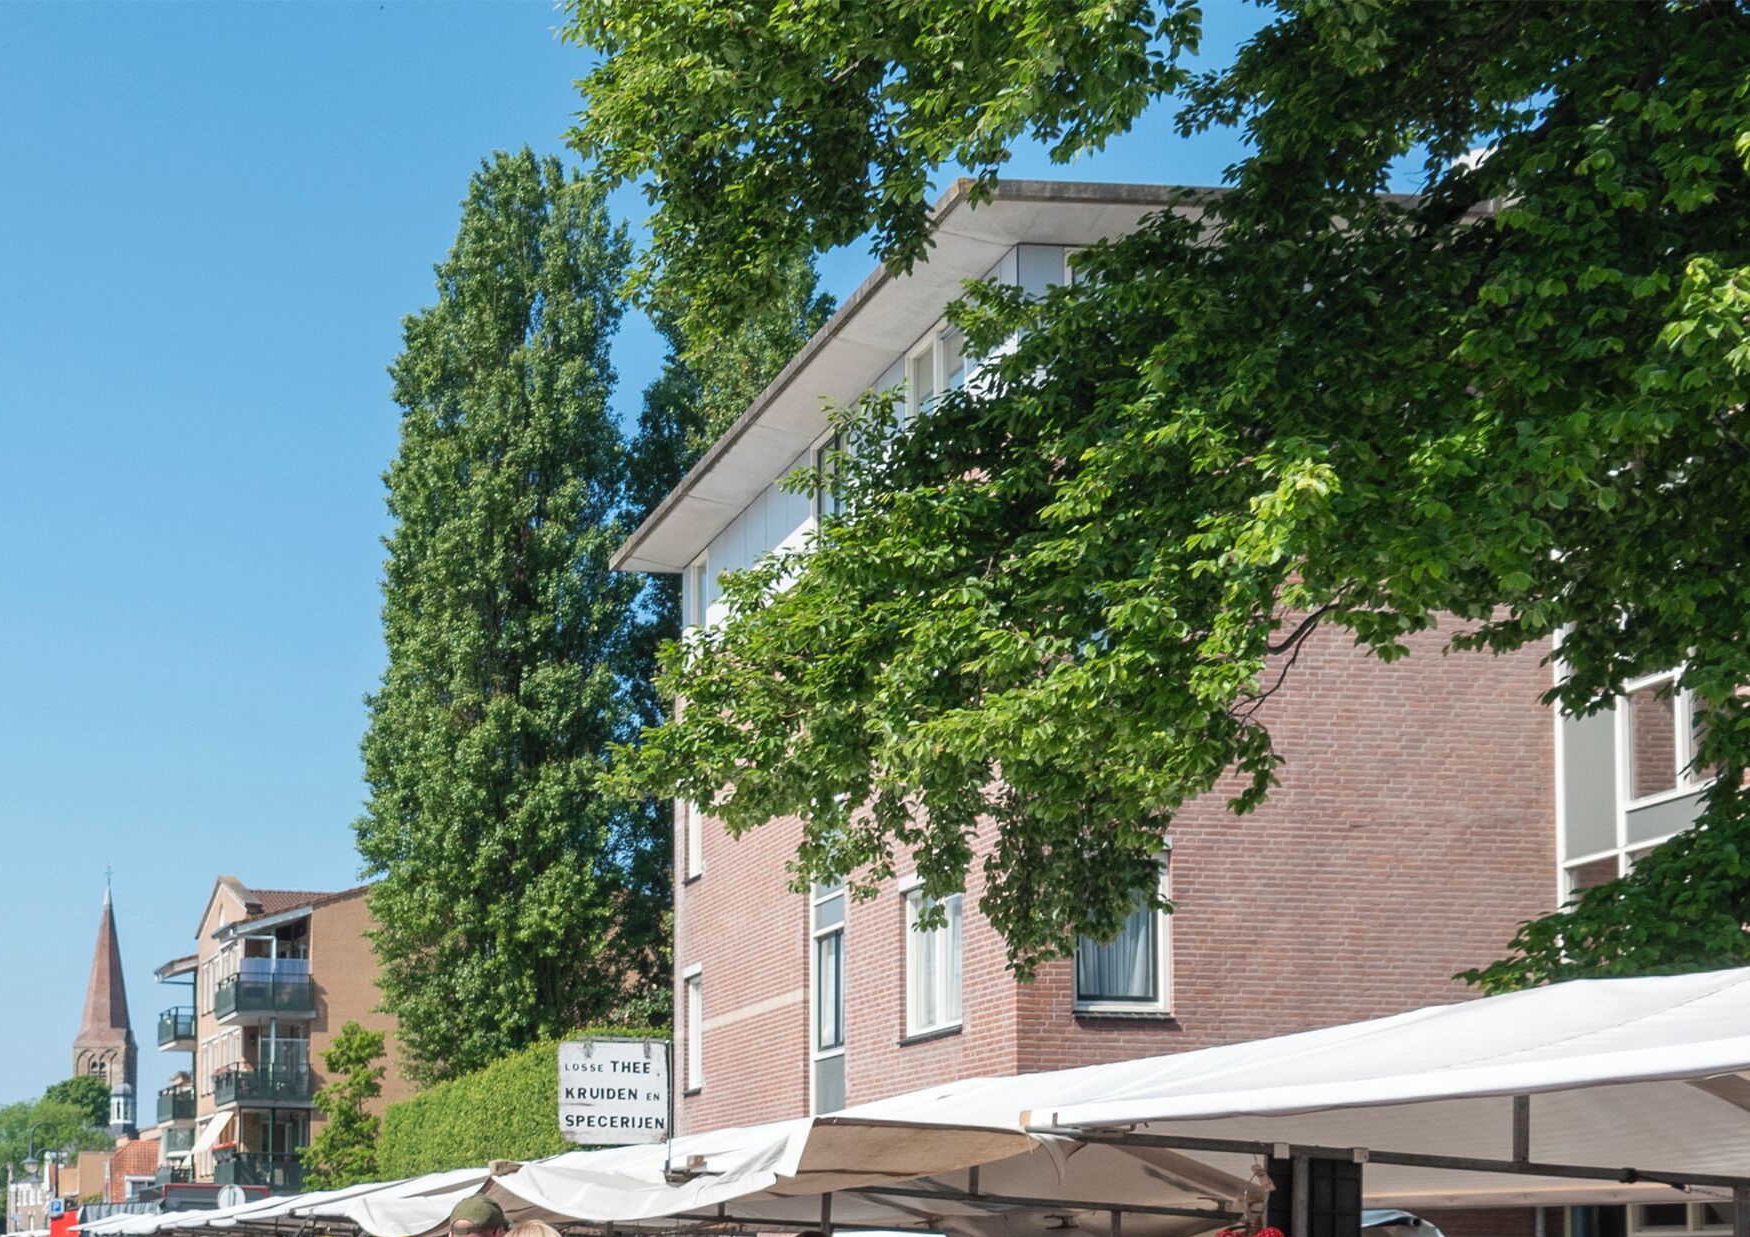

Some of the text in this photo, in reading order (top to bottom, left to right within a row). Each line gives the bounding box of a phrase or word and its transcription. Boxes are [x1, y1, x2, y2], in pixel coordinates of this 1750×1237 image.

[565, 1063, 603, 1072] LOSSE
[565, 1087, 660, 1101] KRUIDEN EN
[565, 1114, 665, 1129] SPECERIJEN
